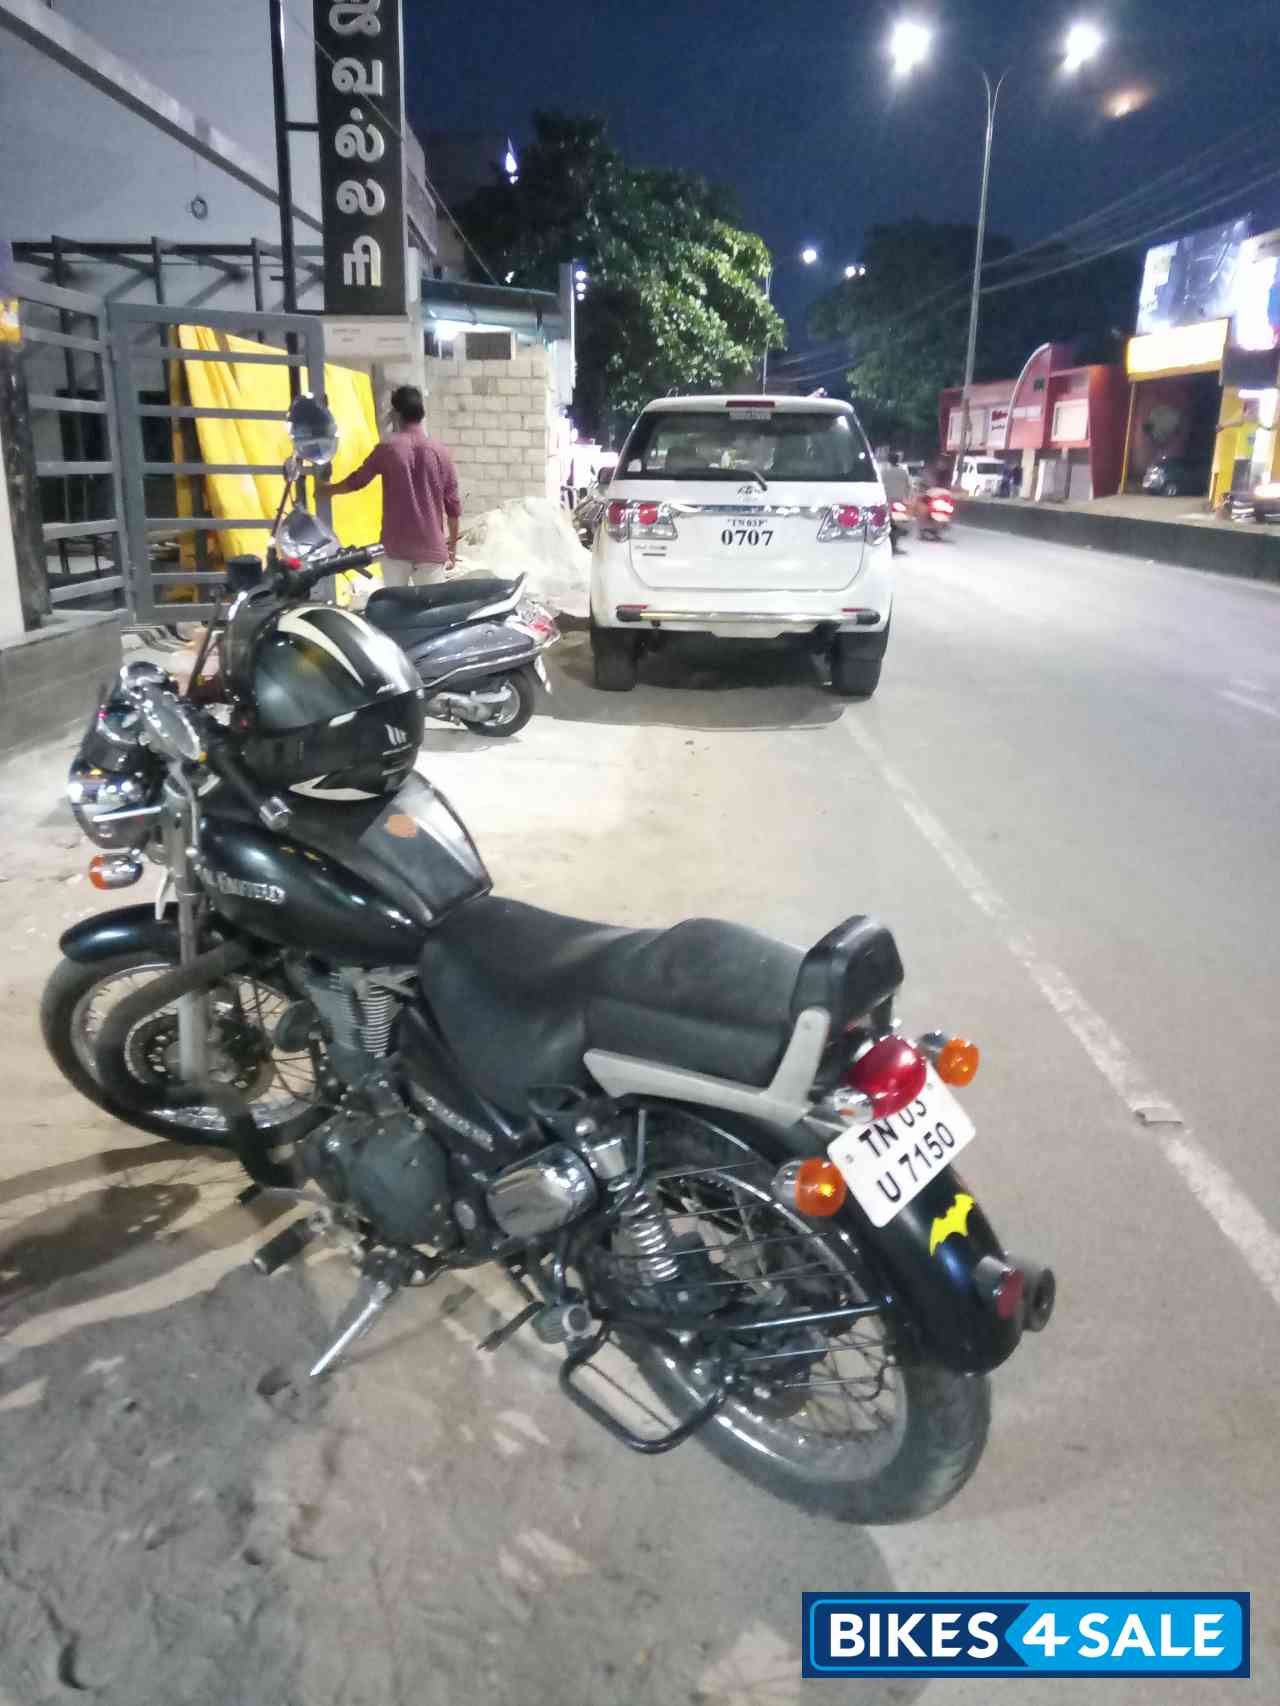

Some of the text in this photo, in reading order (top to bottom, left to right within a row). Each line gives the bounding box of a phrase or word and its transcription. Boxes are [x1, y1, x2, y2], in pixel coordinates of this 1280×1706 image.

[721, 529, 774, 546] 0707
[858, 1117, 899, 1157] TN
[877, 1122, 955, 1202] U 7150
